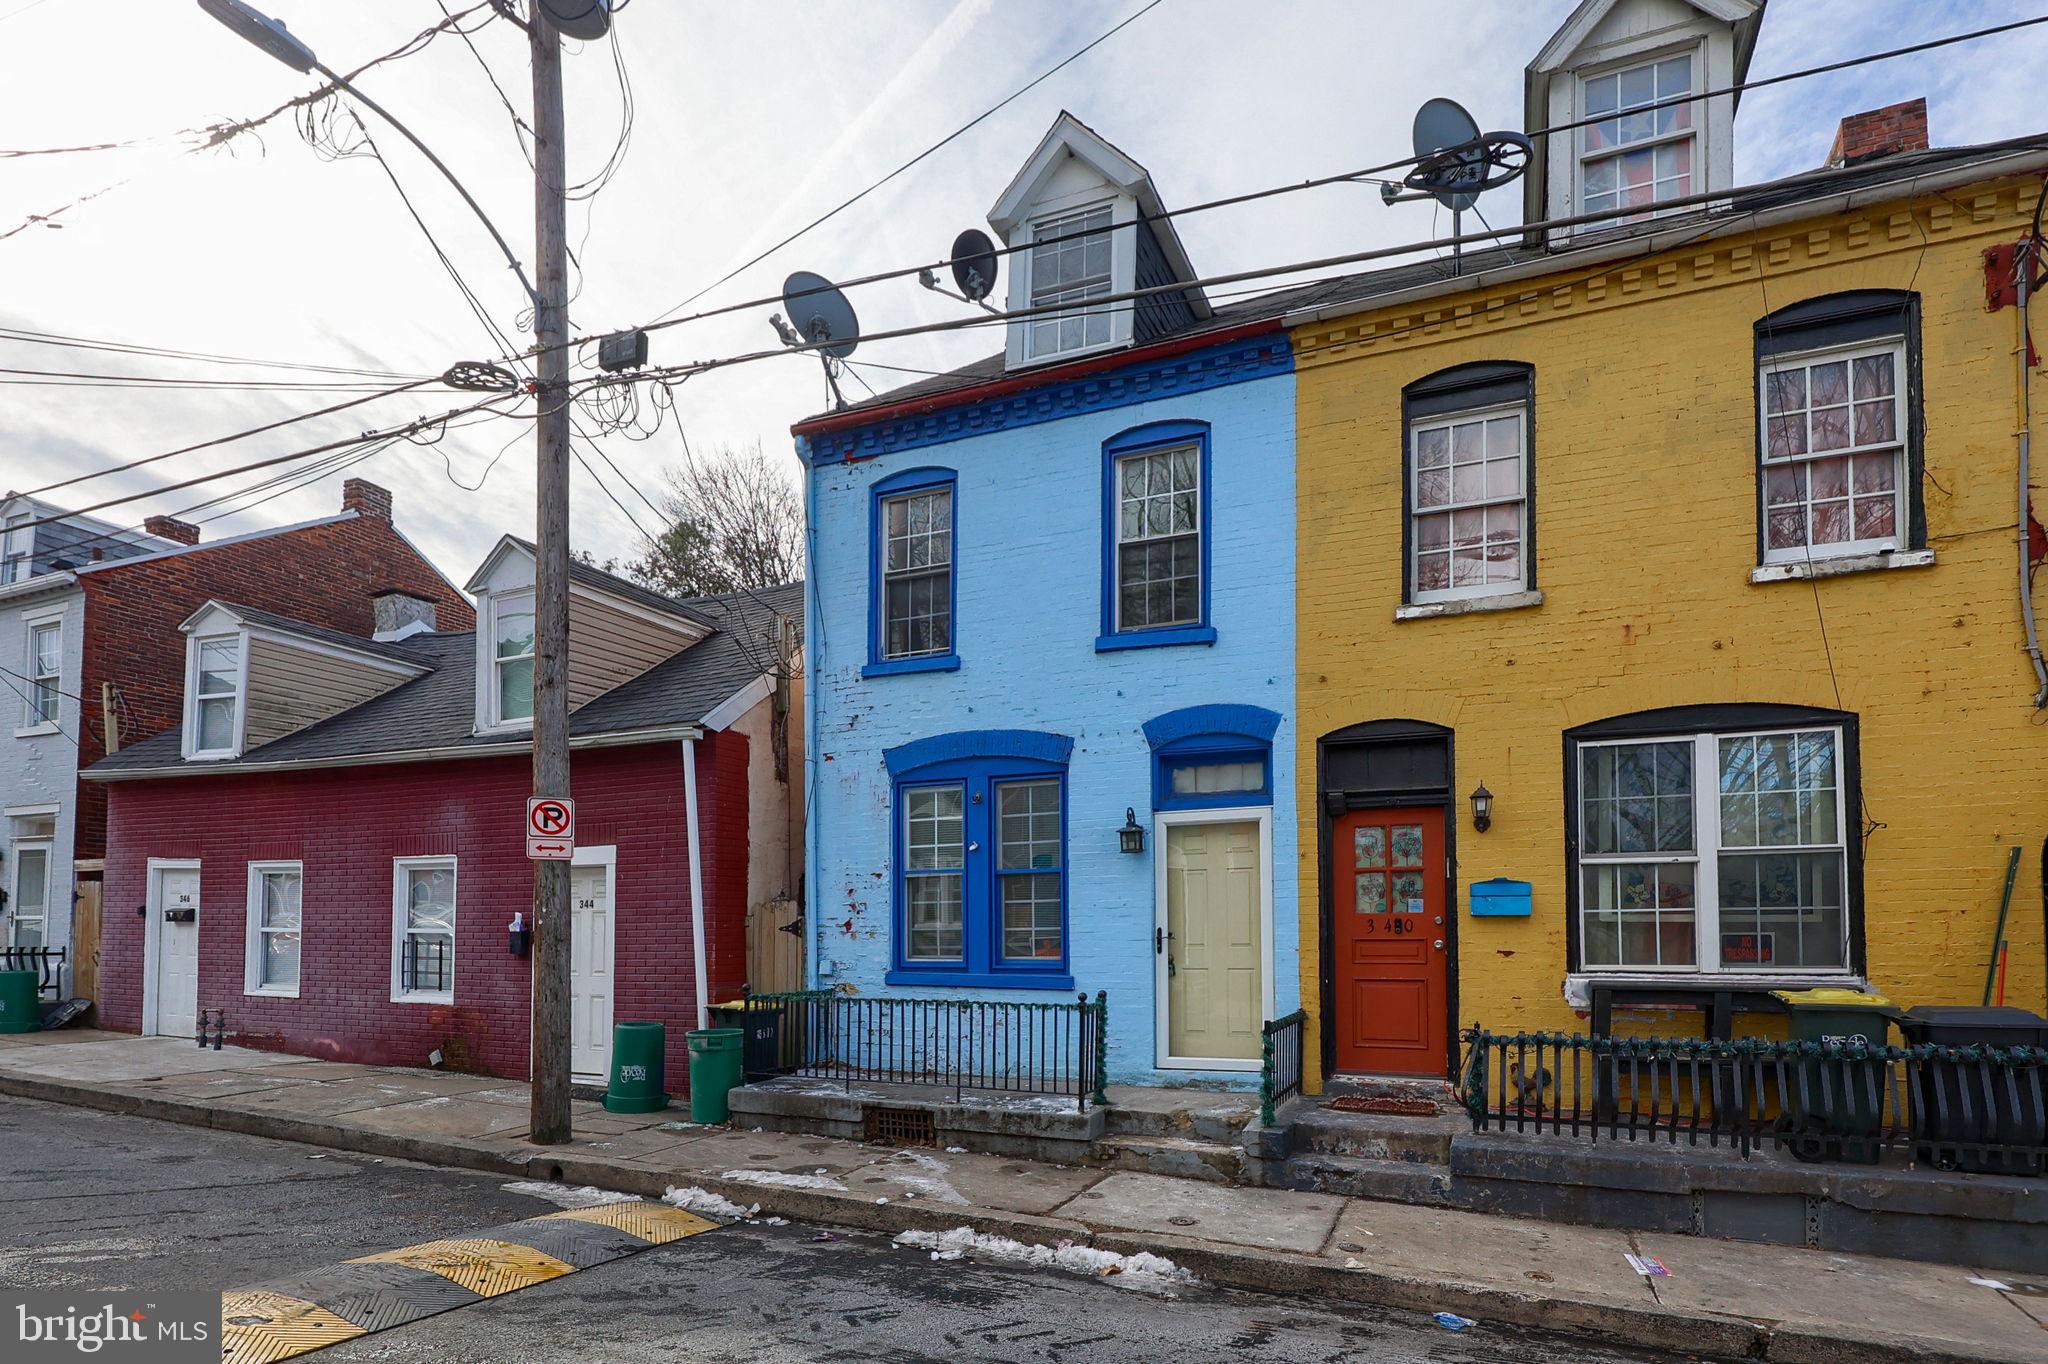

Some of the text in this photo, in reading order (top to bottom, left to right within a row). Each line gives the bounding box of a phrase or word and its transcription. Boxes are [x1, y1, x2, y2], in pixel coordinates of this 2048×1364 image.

[579, 899, 594, 909] 344
[1742, 935, 1752, 947] NO
[1724, 947, 1771, 961] TRESPASSNG
